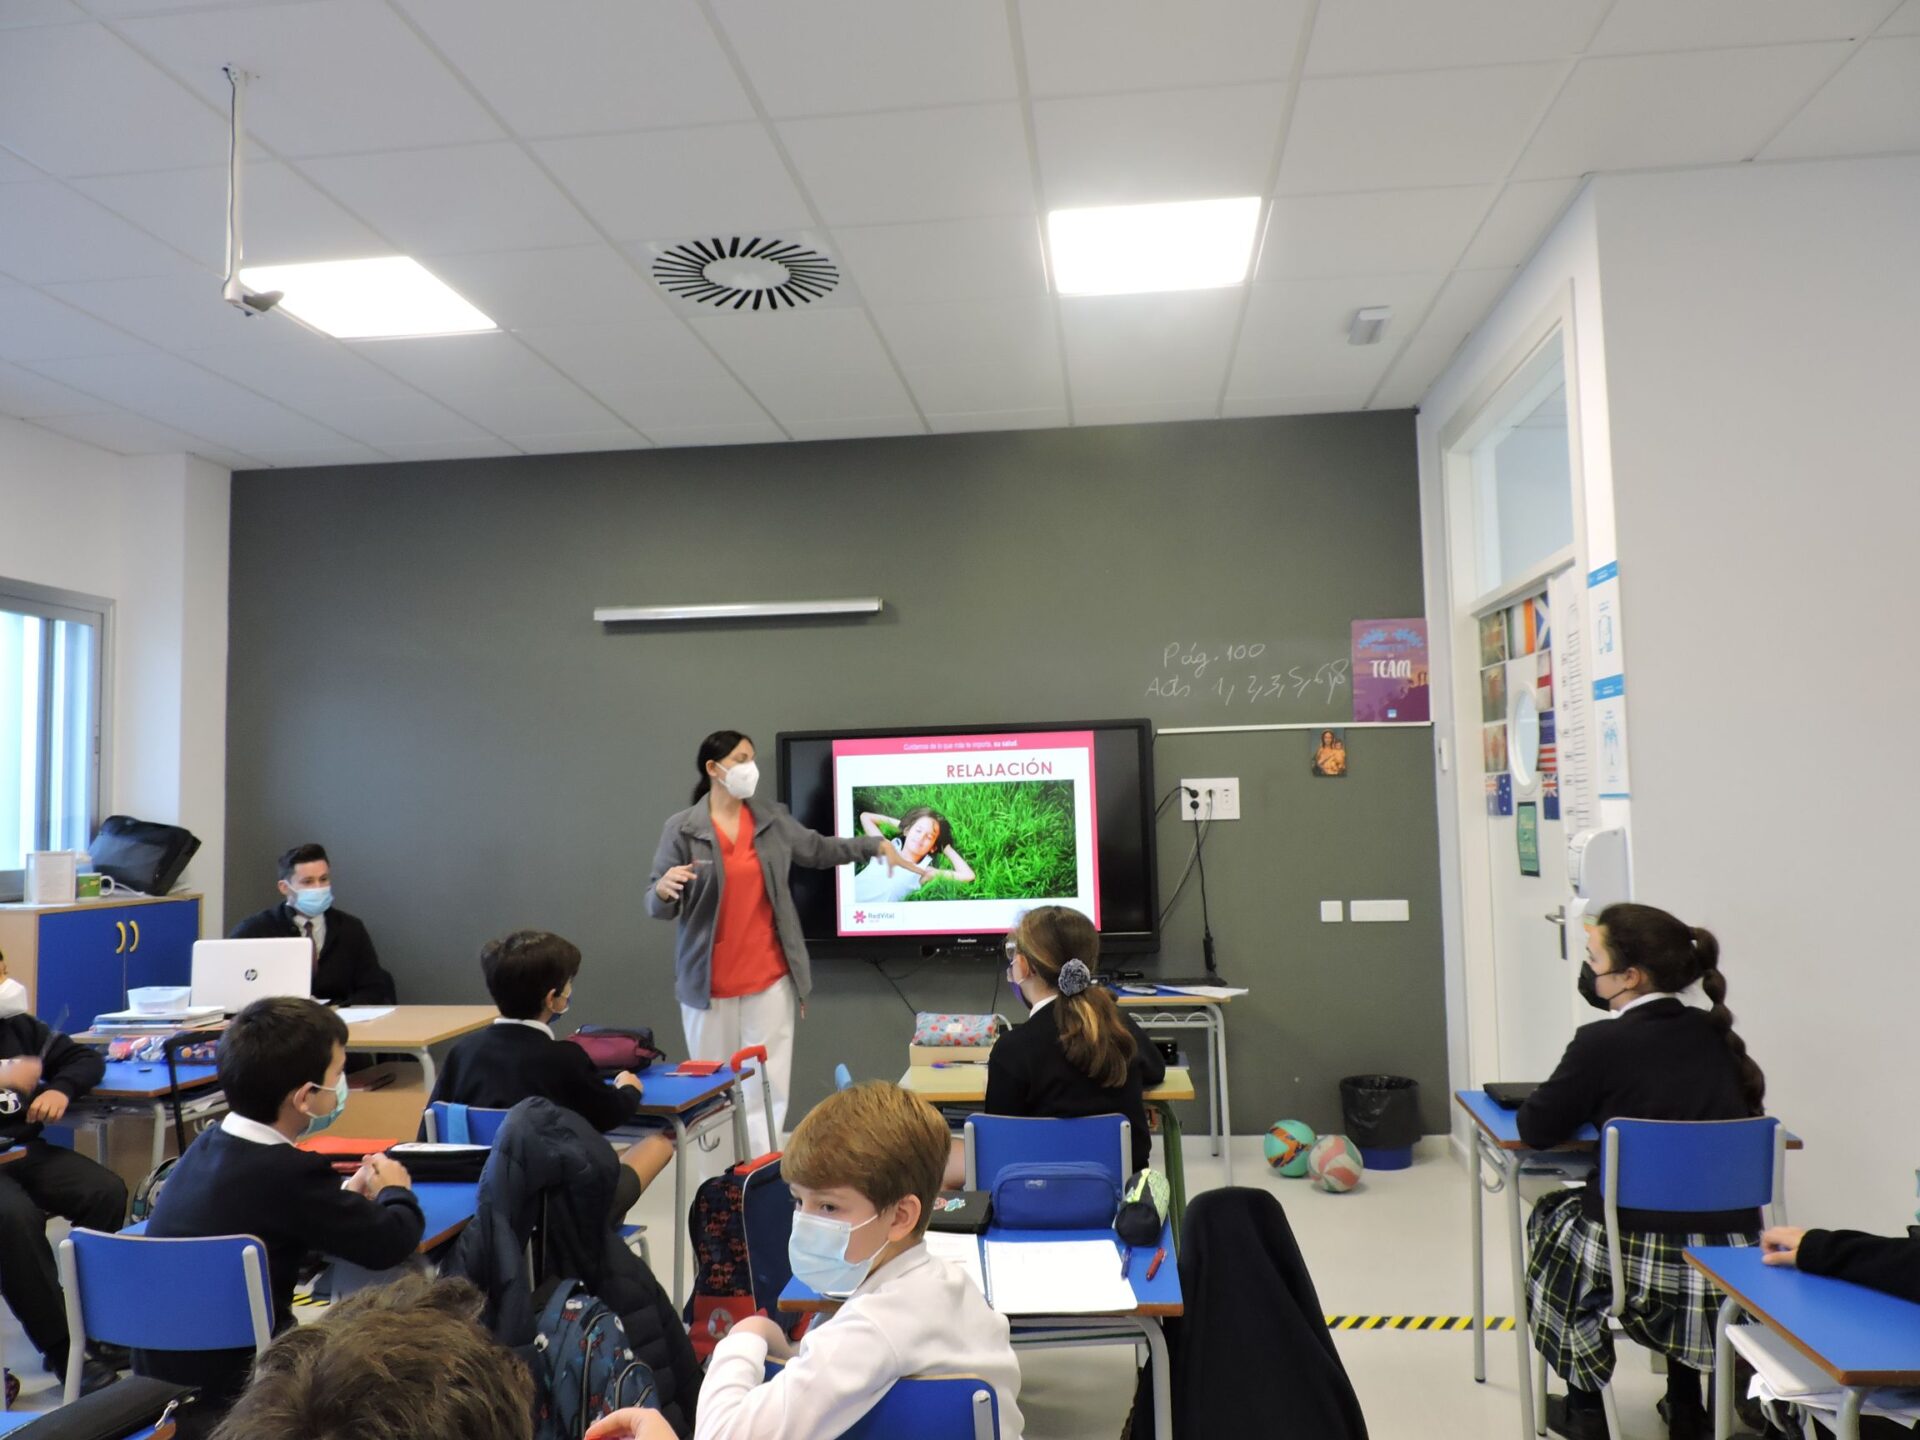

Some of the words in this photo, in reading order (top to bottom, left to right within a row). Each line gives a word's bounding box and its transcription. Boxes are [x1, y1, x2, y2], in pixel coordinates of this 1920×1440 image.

[1227, 644, 1266, 662] 100
[1369, 659, 1412, 678] TEAM
[946, 757, 1053, 779] RELAJACIÓN
